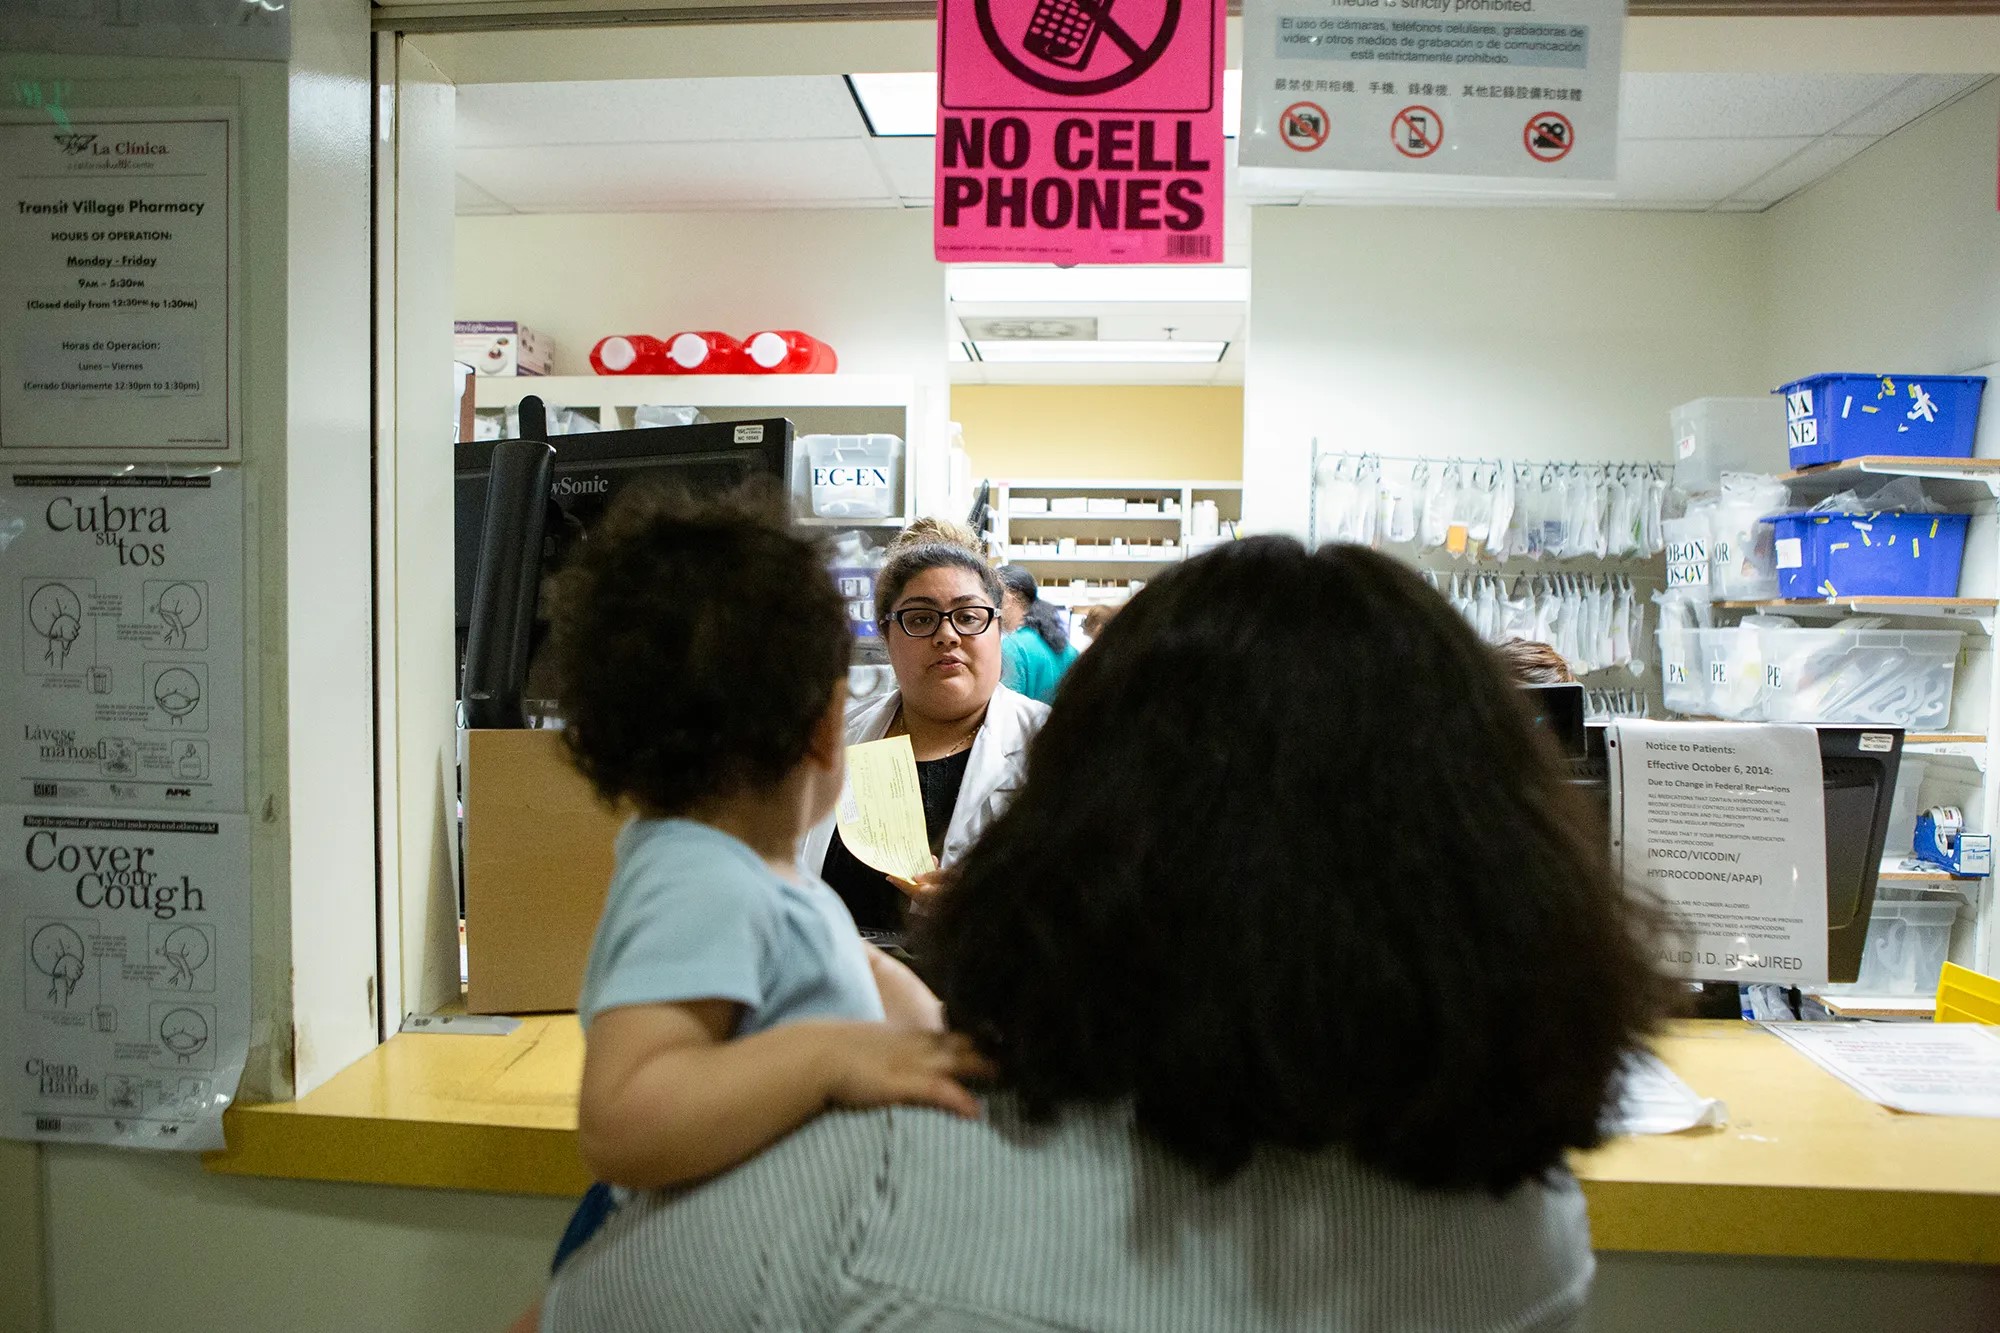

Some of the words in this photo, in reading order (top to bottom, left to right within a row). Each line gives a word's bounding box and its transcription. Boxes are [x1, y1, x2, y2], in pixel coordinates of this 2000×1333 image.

[1401, 0, 1450, 12] strictly
[1455, 0, 1534, 12] prohibited.
[1320, 19, 1334, 29] de
[1503, 25, 1566, 37] grabadoras
[1570, 26, 1584, 38] de
[1326, 36, 1353, 45] otros
[1357, 36, 1397, 46] medios
[1401, 36, 1414, 46] de
[1487, 39, 1500, 49] de
[93, 143, 110, 156] La
[943, 117, 1030, 170] NO
[1054, 118, 1210, 172] CELL
[19, 201, 68, 214] Transit
[74, 200, 124, 217] Village
[129, 200, 205, 216] Pharmacy
[943, 176, 1204, 231] PHONES
[51, 232, 89, 241] HOURS
[92, 232, 105, 241] OF
[108, 232, 172, 241] OPERATION:
[67, 256, 112, 268] Monday
[122, 256, 156, 268] Friday
[27, 300, 60, 310] (Closed
[63, 300, 86, 311] daily
[89, 300, 110, 309] from
[151, 300, 159, 308] to
[62, 342, 89, 350] Horas
[115, 382, 151, 392] 12:30pm
[1790, 422, 1815, 446] NE
[814, 468, 886, 486] EC-EN
[46, 495, 170, 534] Cubra
[96, 532, 118, 546] su
[117, 538, 165, 567] tos
[1715, 543, 1728, 562] OR
[1670, 664, 1684, 682] PA
[1713, 664, 1726, 682] PE
[1768, 664, 1781, 688] PE
[1646, 742, 1676, 751] Notice
[1680, 744, 1690, 752] to
[1693, 744, 1736, 755] Patients:
[1648, 760, 1689, 771] Effective
[1692, 762, 1731, 773] October
[1734, 765, 1743, 775] 6,
[1746, 765, 1773, 775] 2014:
[1675, 780, 1703, 790] Change
[1715, 782, 1743, 791] Federal
[26, 830, 154, 872] Cover
[1648, 848, 1741, 864] (NORCO/VICODIN/
[105, 870, 157, 889] your
[1647, 868, 1763, 886] HYDROCODONE/APAP)
[76, 872, 206, 920] Cough
[1697, 952, 1720, 965] I.D.
